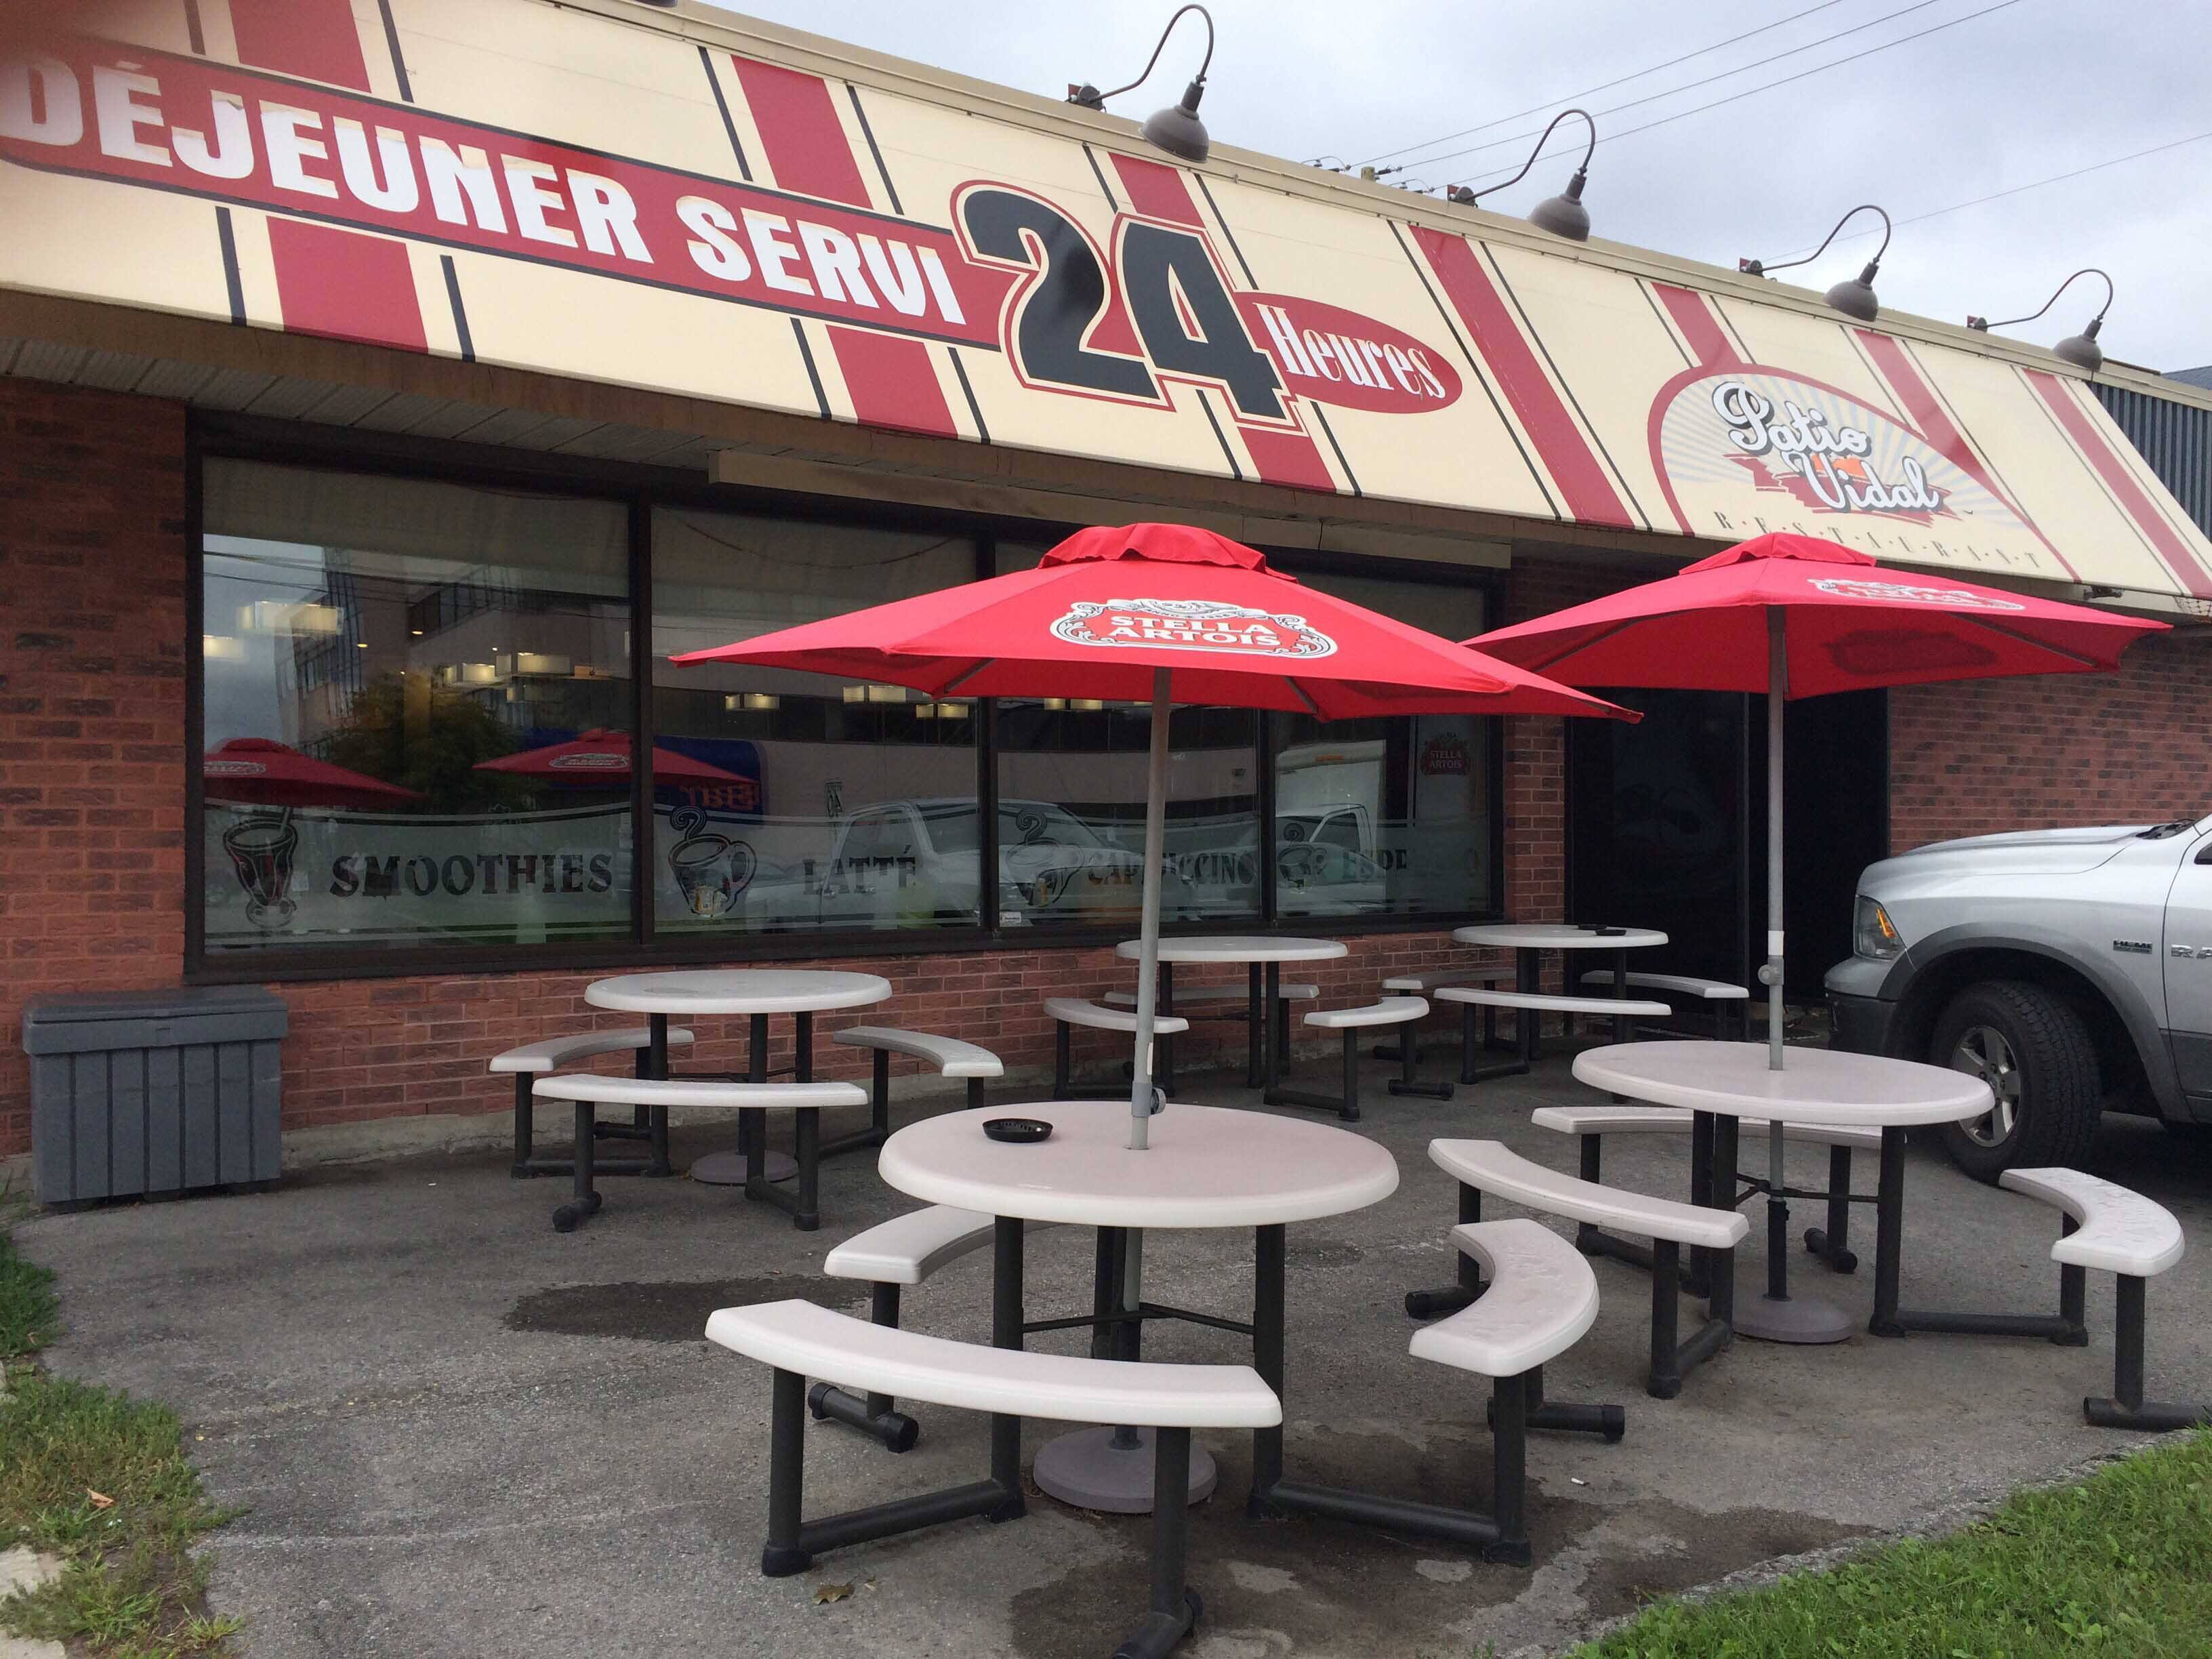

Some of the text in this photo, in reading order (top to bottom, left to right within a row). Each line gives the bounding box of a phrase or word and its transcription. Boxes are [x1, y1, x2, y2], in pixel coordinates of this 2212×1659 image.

[675, 195, 967, 325] SERVI
[962, 188, 1446, 420] 24 Heures
[1712, 382, 1871, 457] Patio
[1780, 451, 1943, 513] Vidal
[1107, 626, 1281, 647] ARTOIS
[1110, 615, 1276, 635] STELLA
[1429, 749, 1462, 760] STELLA
[1429, 759, 1462, 769] ARTOIS
[329, 853, 613, 898] SMOOTHIES
